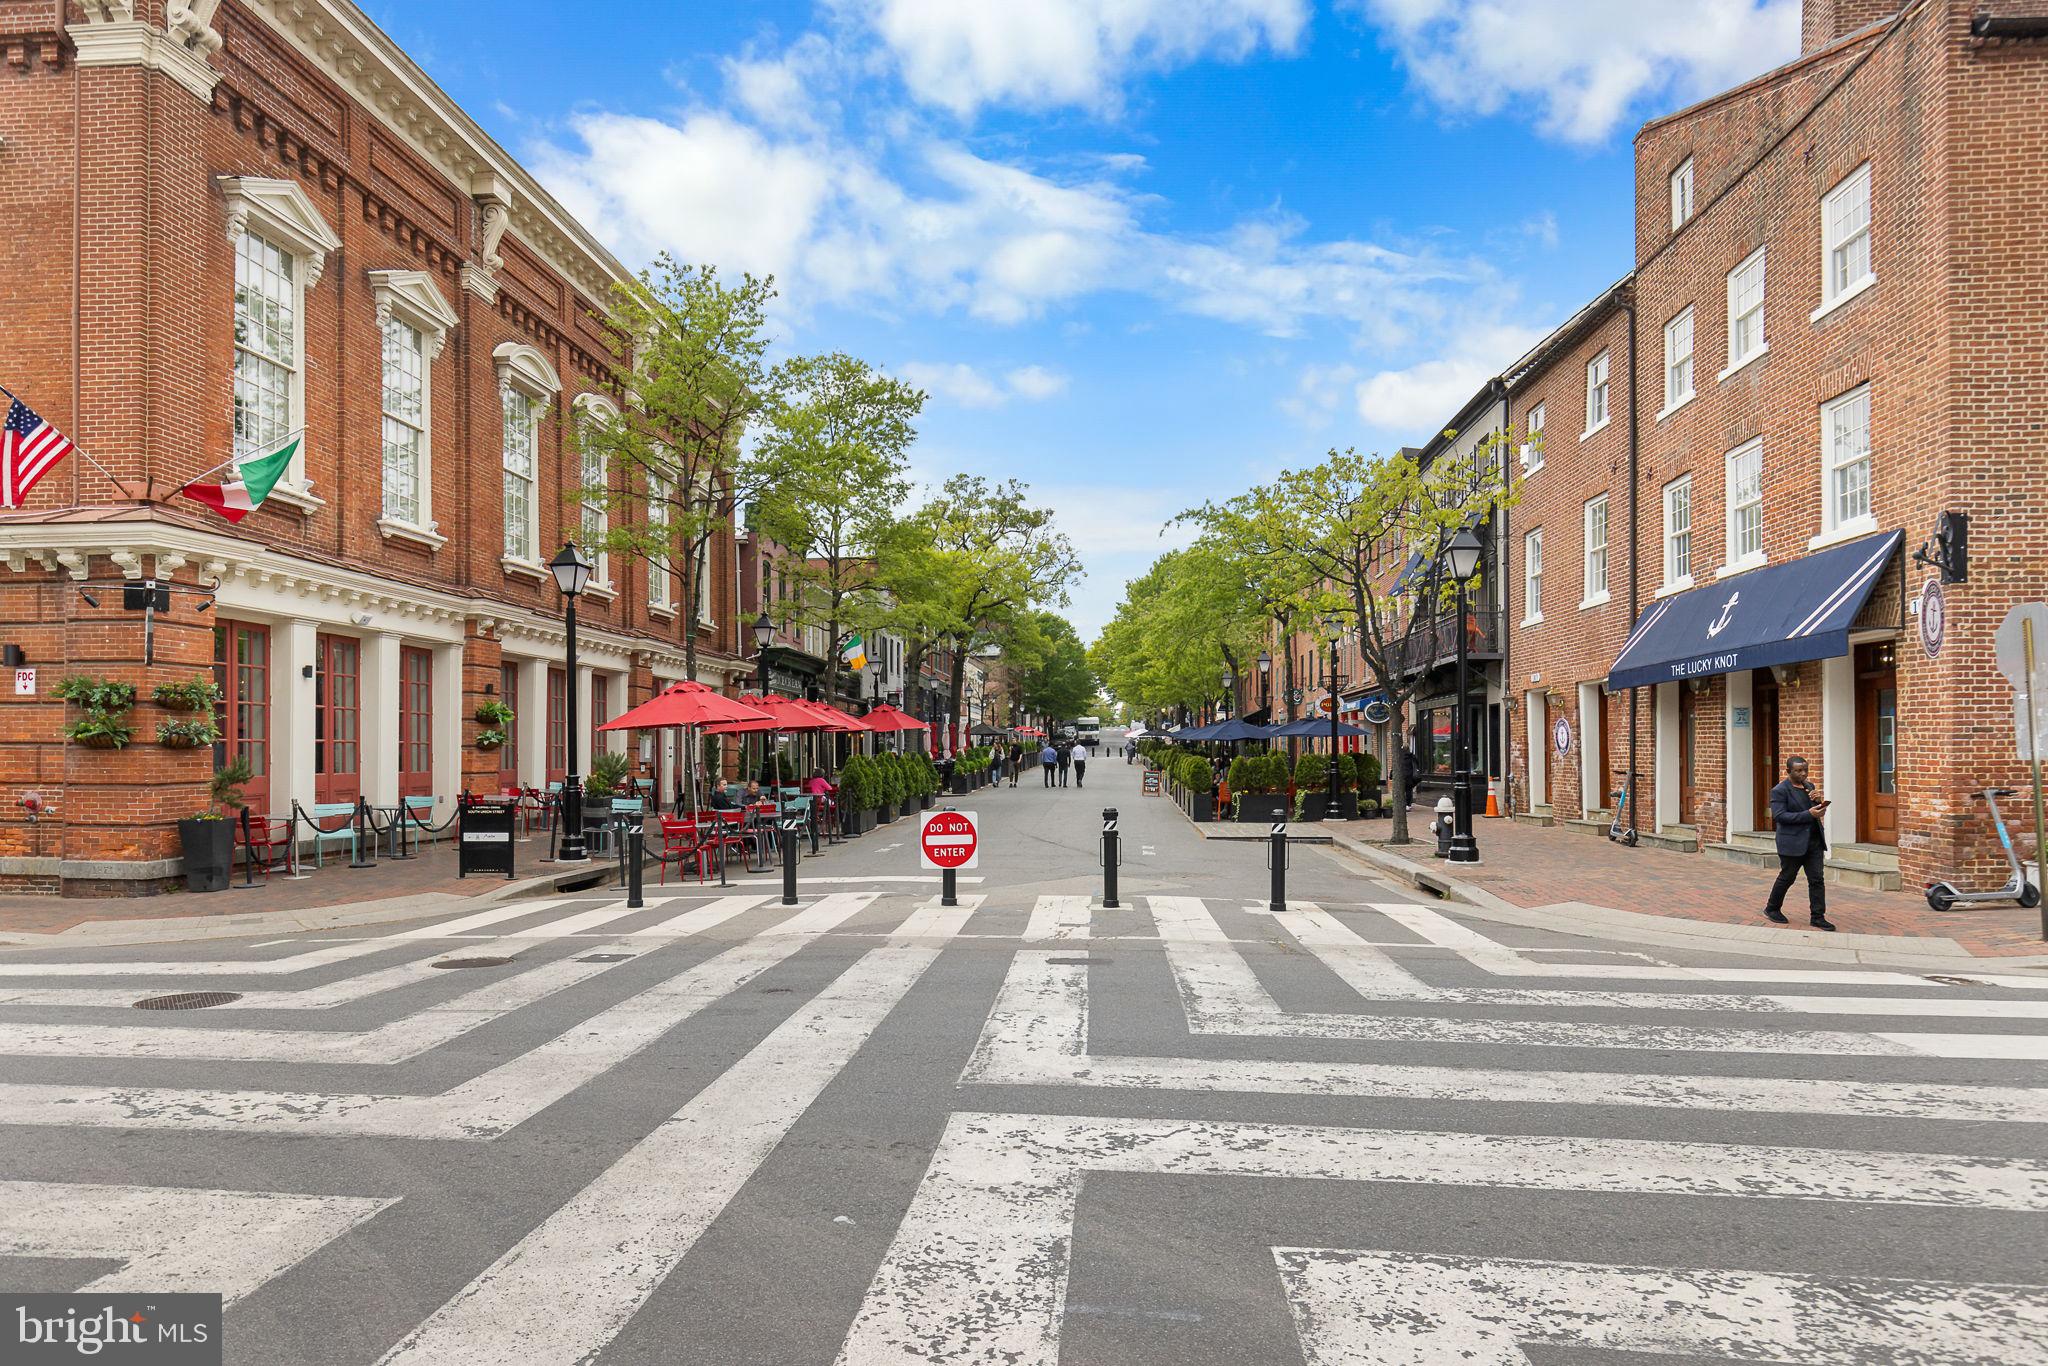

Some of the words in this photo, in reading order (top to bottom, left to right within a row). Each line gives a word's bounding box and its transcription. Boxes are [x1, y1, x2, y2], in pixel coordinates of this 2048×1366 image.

[1671, 663, 1686, 677] THE
[1687, 657, 1713, 674] LUCKY
[1714, 653, 1739, 669] KNOT
[17, 671, 34, 681] FDC
[929, 823, 943, 833] DO
[949, 822, 969, 832] NOT
[934, 847, 966, 857] ENTER
